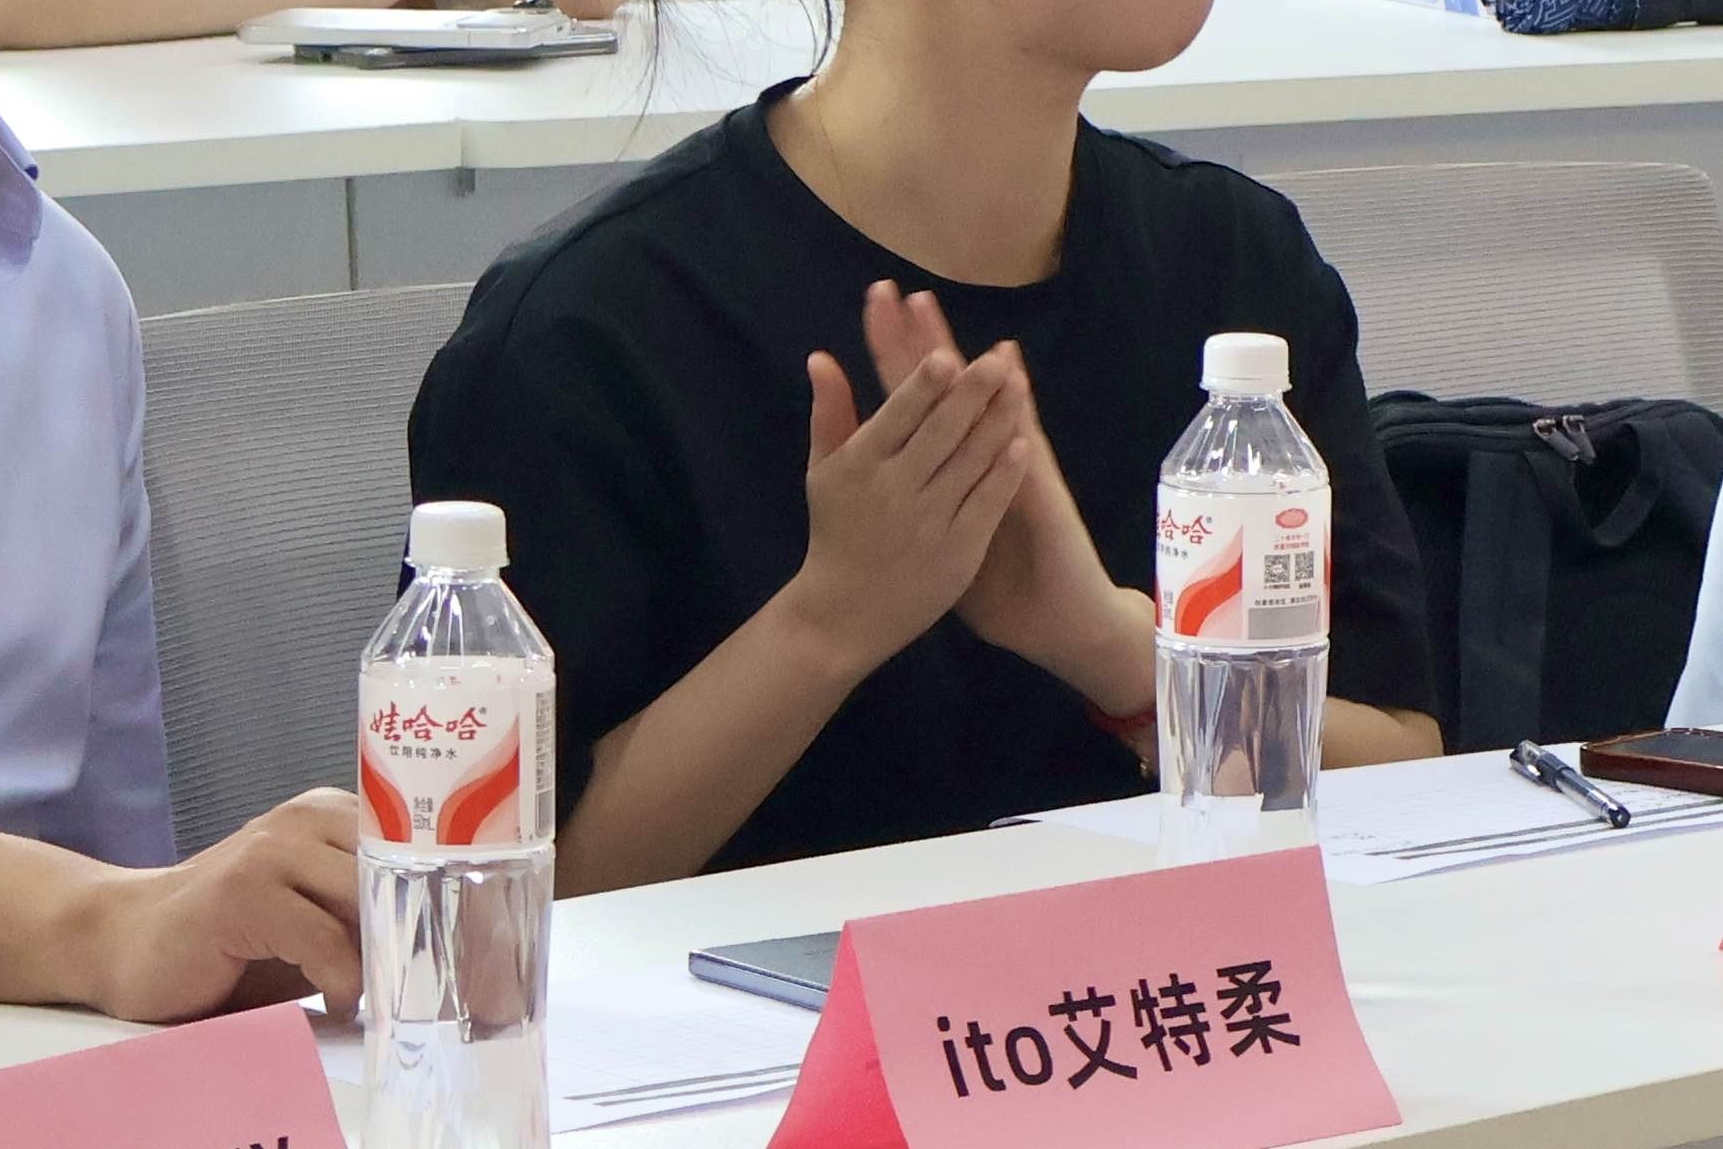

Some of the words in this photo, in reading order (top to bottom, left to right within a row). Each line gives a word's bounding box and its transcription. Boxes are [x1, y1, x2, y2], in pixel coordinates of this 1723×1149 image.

[1157, 508, 1213, 545] 哈哈
[370, 701, 487, 742] 娃哈哈
[936, 959, 1301, 1098] ito艾特柔
